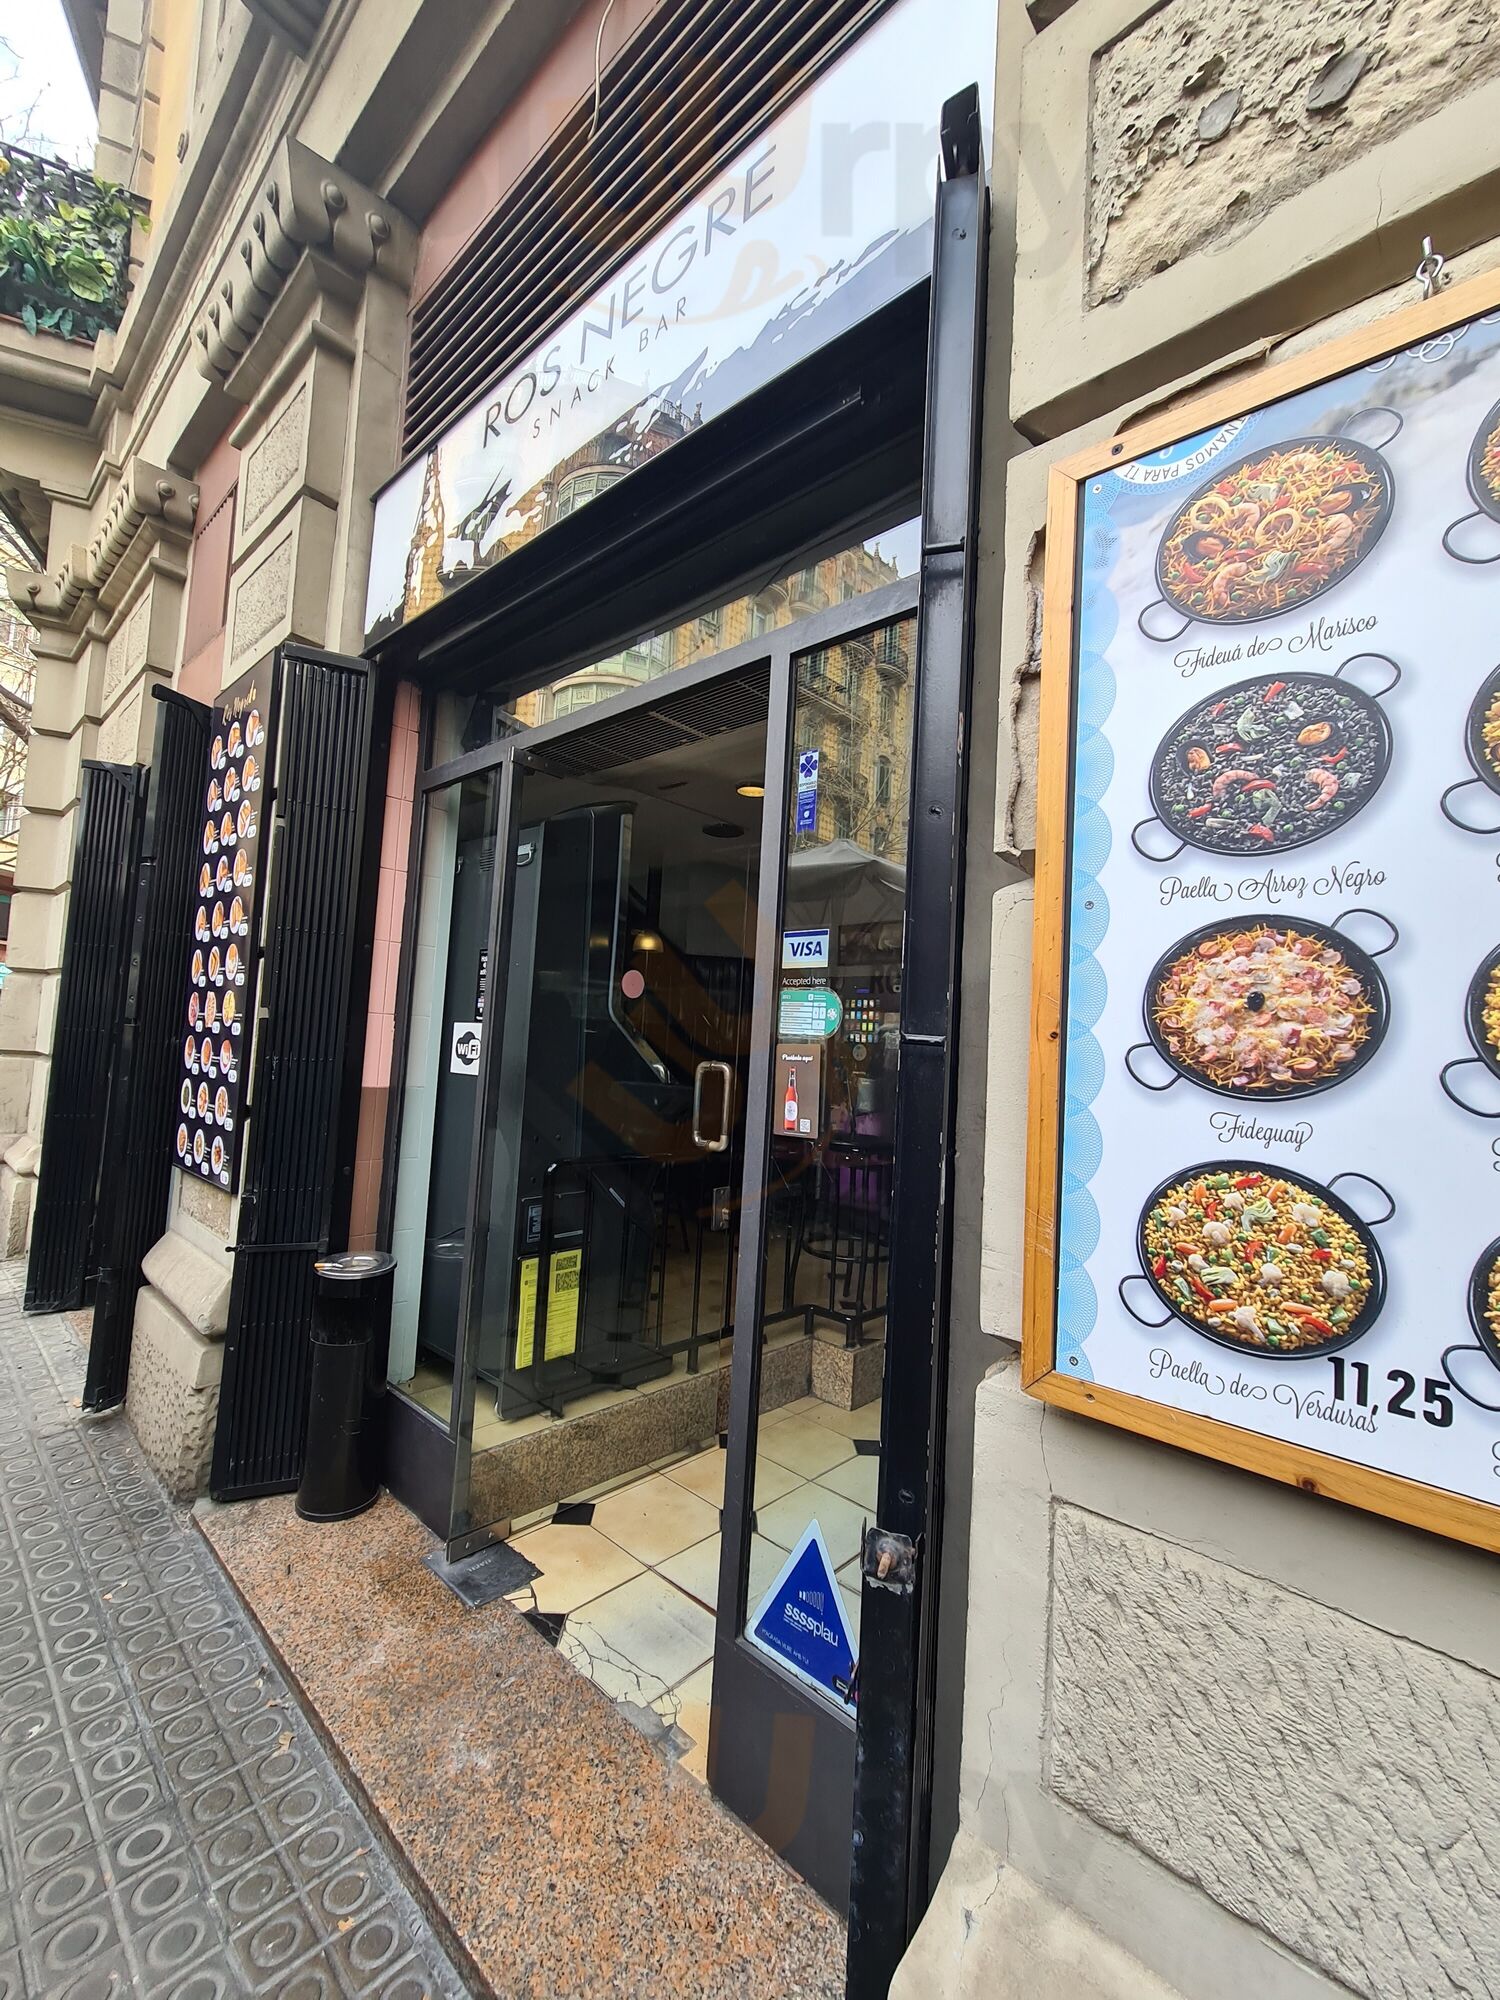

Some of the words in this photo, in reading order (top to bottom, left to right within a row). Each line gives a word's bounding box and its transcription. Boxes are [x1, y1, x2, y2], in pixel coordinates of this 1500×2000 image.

[483, 345, 561, 449] ROS
[579, 145, 777, 366] NEGRE
[533, 355, 615, 439] SNACK
[639, 296, 687, 352] BAR
[1124, 464, 1140, 480] TI
[1144, 466, 1179, 482] PARA
[1174, 645, 1242, 678] Fideuá
[1247, 636, 1282, 658] de
[1288, 615, 1378, 652] Marisco
[1160, 876, 1233, 905] Paella
[1238, 868, 1308, 904] Arroz
[1313, 861, 1387, 895] Negro
[789, 941, 822, 957] VISA
[782, 976, 811, 987] Accepted
[811, 976, 827, 985] here
[1209, 1111, 1314, 1152] Fideguay
[1149, 1348, 1225, 1396] Paella
[1229, 1372, 1267, 1400] de
[1273, 1383, 1379, 1433] Verduras
[1327, 1356, 1453, 1428] 11,25
[785, 1603, 838, 1647] ssssplau
